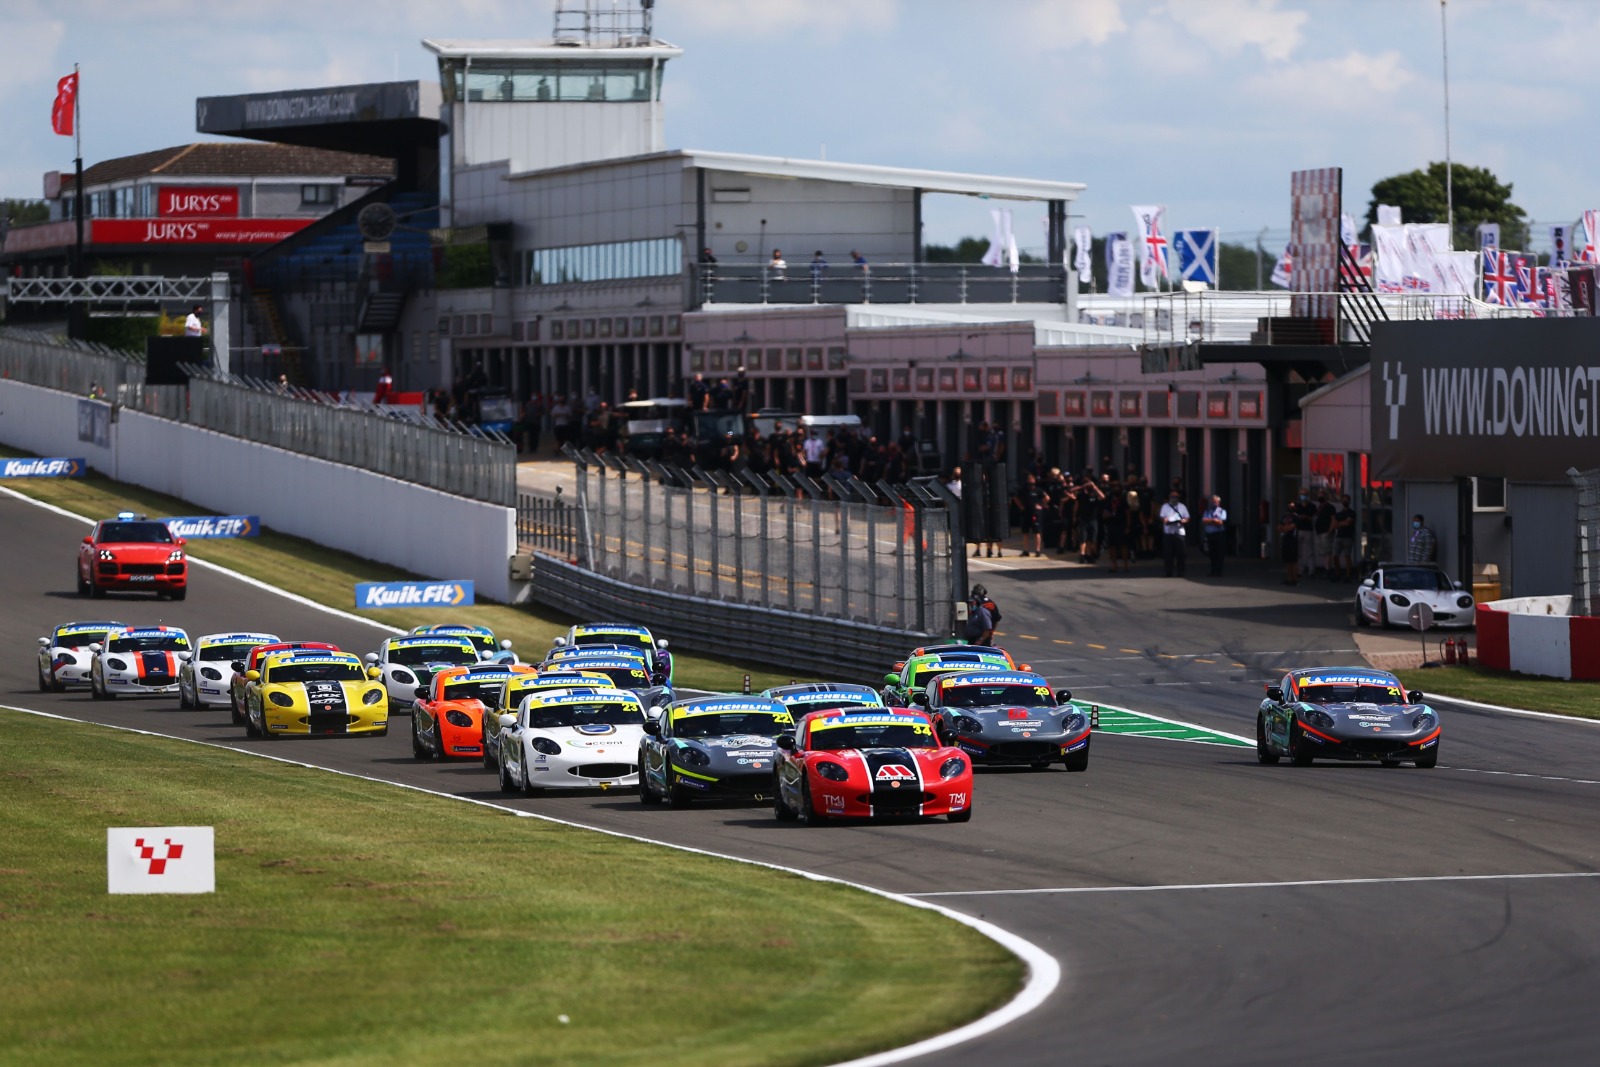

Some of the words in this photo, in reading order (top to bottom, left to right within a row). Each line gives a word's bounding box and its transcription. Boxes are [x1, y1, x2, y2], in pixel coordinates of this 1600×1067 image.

[166, 193, 220, 213] JURYS
[143, 222, 197, 242] JURYS
[1422, 365, 1600, 438] WWW.DONINGT
[595, 626, 640, 634] MICHELIN
[943, 663, 1001, 671] MICHELIN
[630, 669, 646, 678] 62
[539, 678, 599, 686] MICHELIN
[1325, 677, 1387, 685] MICHELIN
[1033, 686, 1050, 696] 29
[1386, 686, 1401, 696] 21
[622, 703, 639, 712] 23
[704, 704, 772, 712] MICHELIN
[772, 714, 791, 724] 22
[844, 715, 915, 723] MICHELIN
[912, 725, 932, 737] 34
